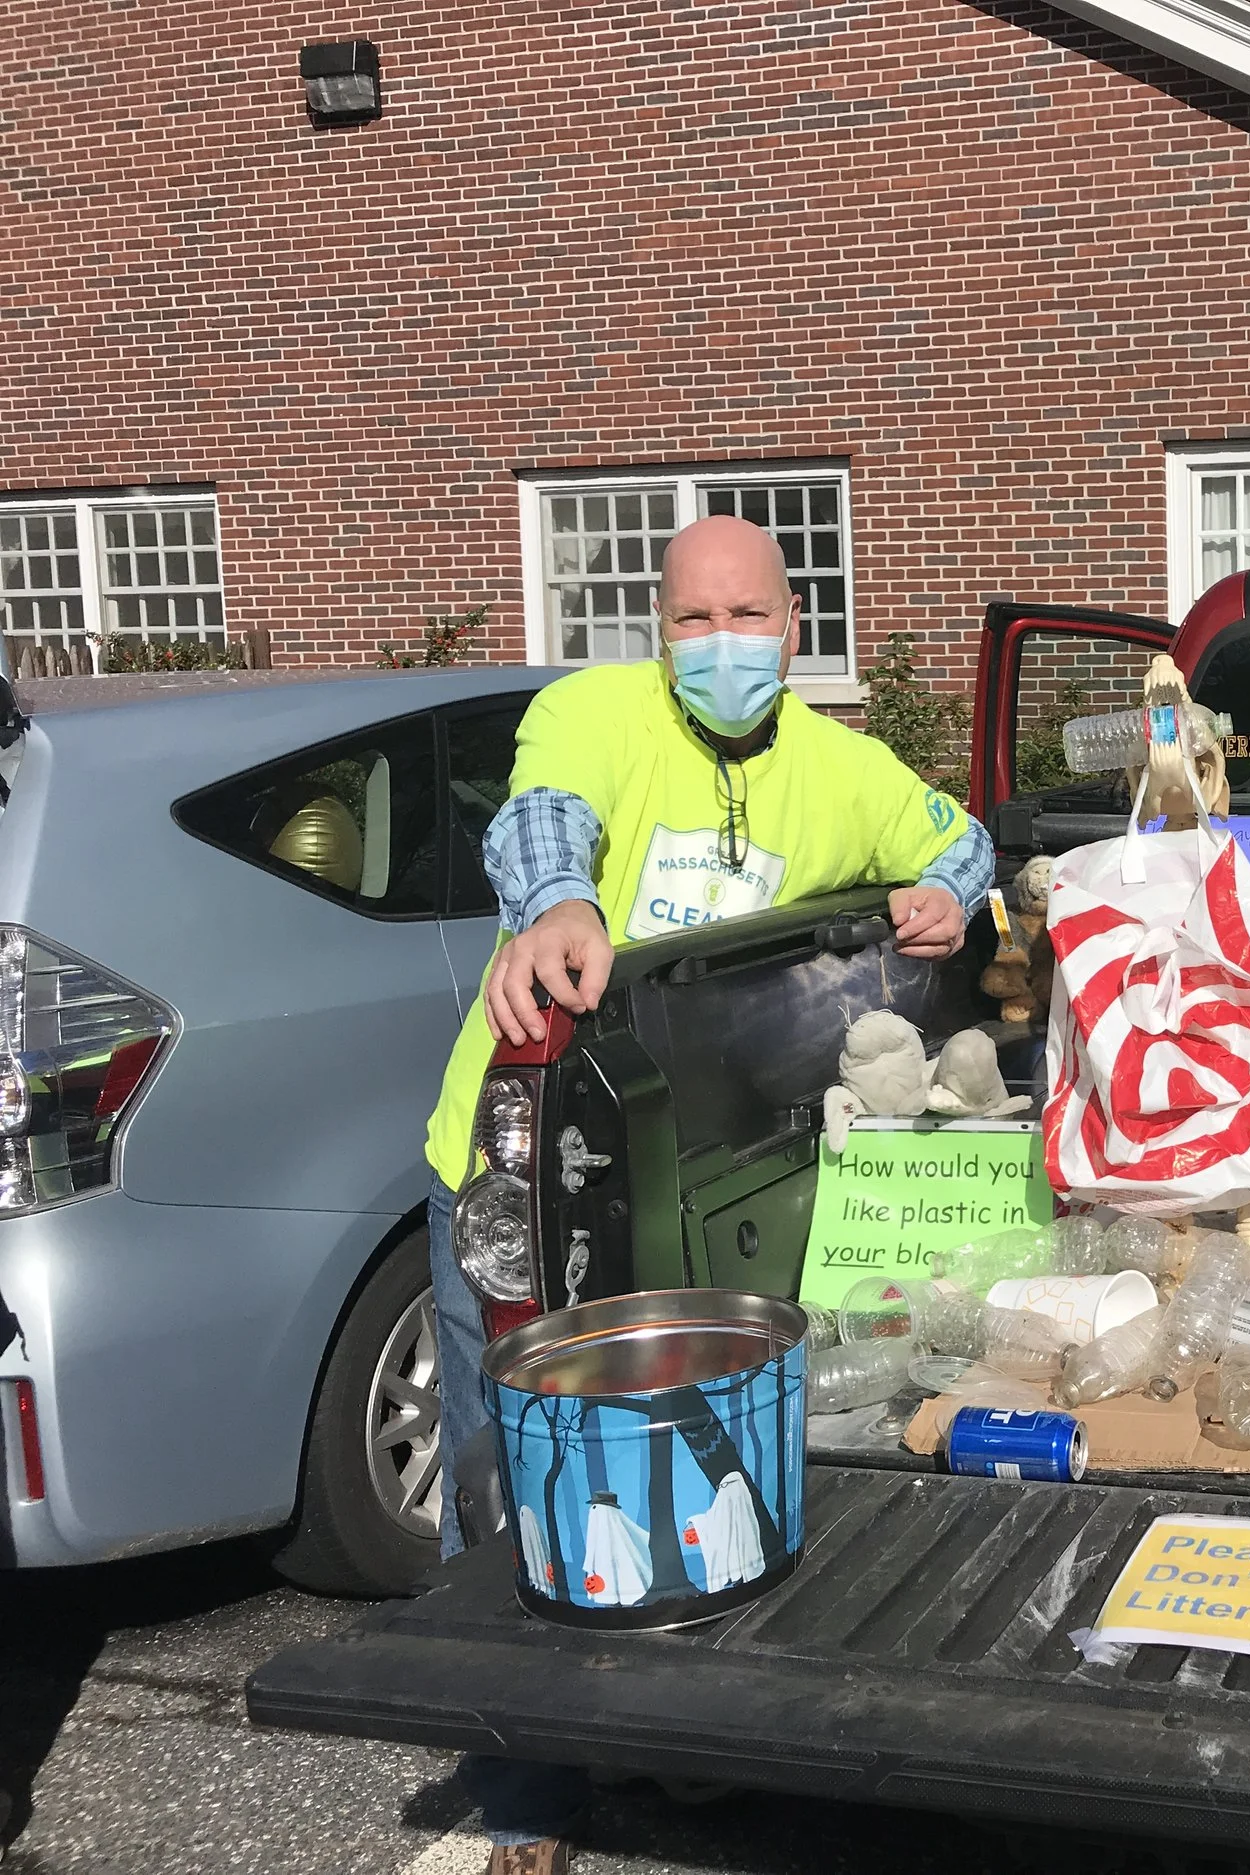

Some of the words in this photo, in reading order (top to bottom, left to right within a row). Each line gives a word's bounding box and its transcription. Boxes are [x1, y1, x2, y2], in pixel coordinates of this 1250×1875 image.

[658, 857, 770, 897] MASSACHUSETTS
[649, 898, 725, 927] CLEA
[838, 1153, 894, 1177] How
[904, 1153, 979, 1177] would
[988, 1161, 1034, 1185] you
[842, 1197, 890, 1222] like
[900, 1198, 991, 1230] plastic
[1002, 1200, 1025, 1225] in
[823, 1244, 886, 1268] your
[896, 1242, 934, 1266] blo
